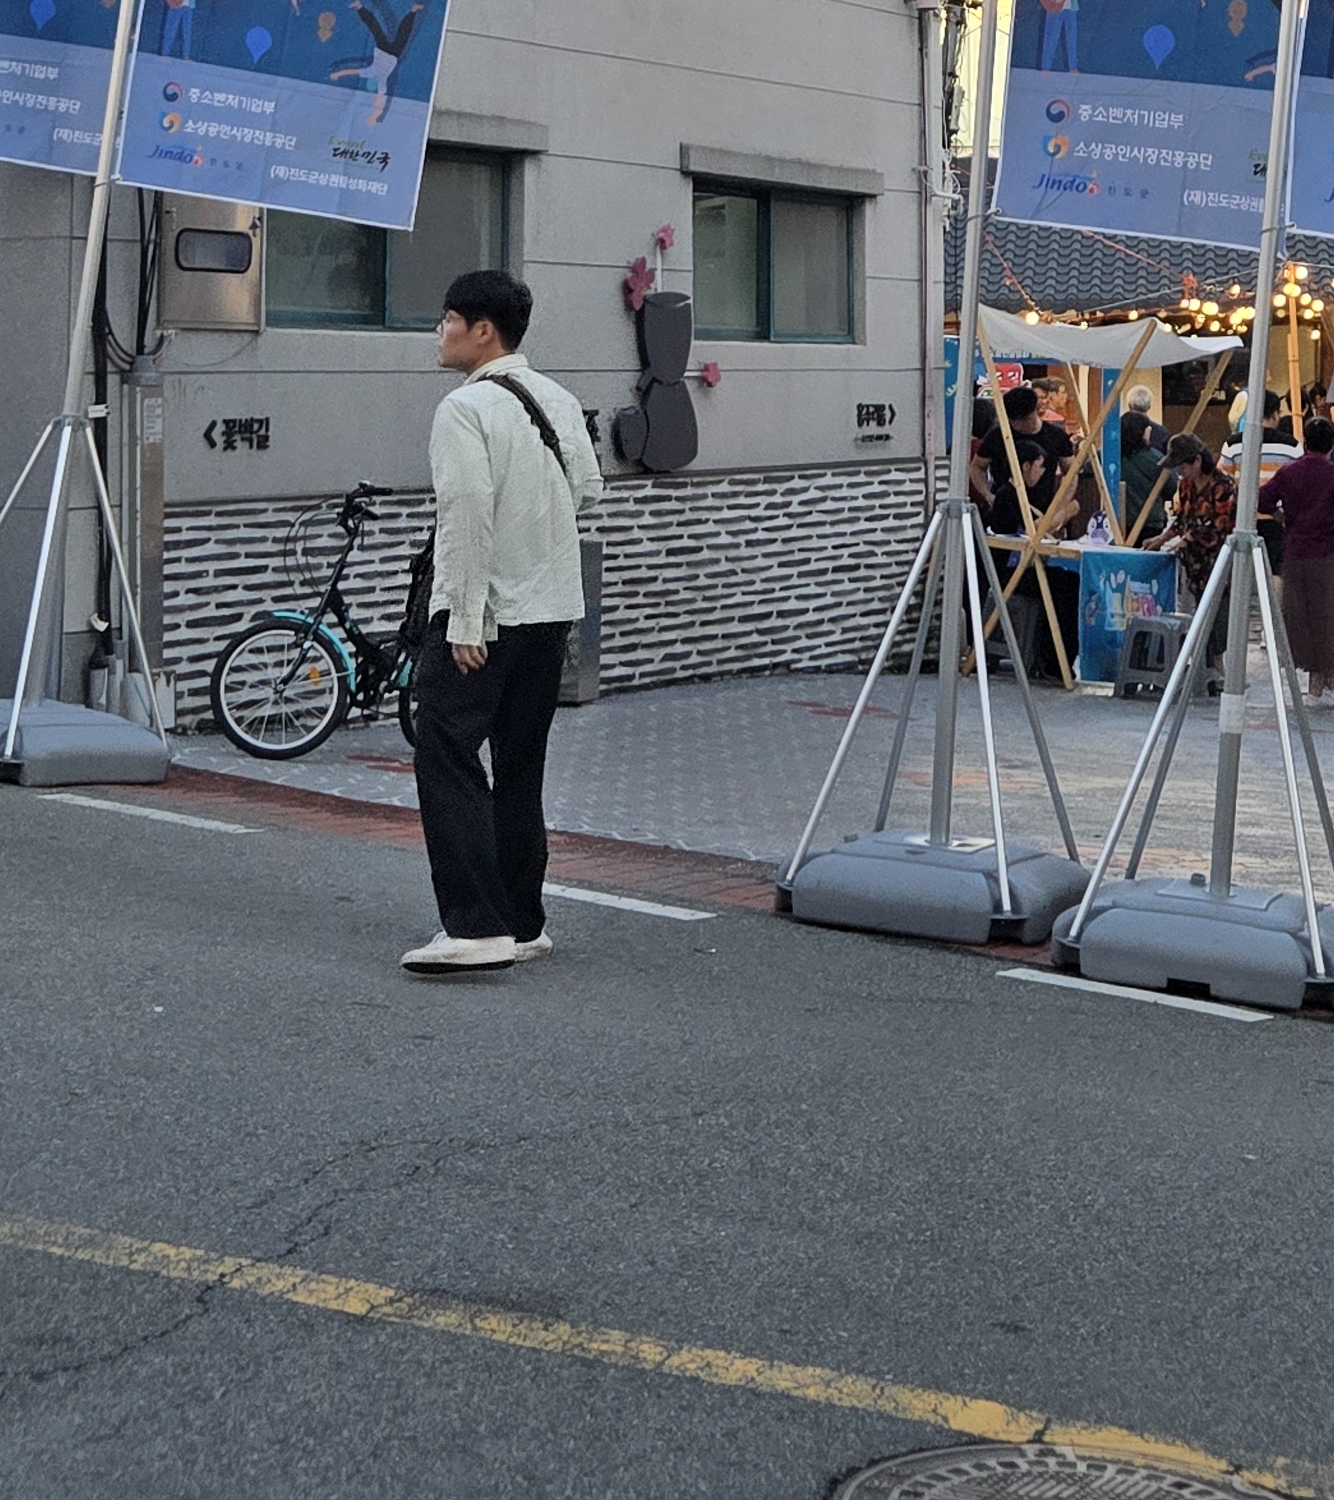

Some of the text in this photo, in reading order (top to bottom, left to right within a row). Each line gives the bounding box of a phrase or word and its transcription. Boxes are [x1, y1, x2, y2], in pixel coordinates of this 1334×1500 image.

[1078, 105, 1184, 130] 중소벤처기업부
[1074, 141, 1212, 170] 소상공인시장진흥공단
[1033, 173, 1088, 193] Jindo
